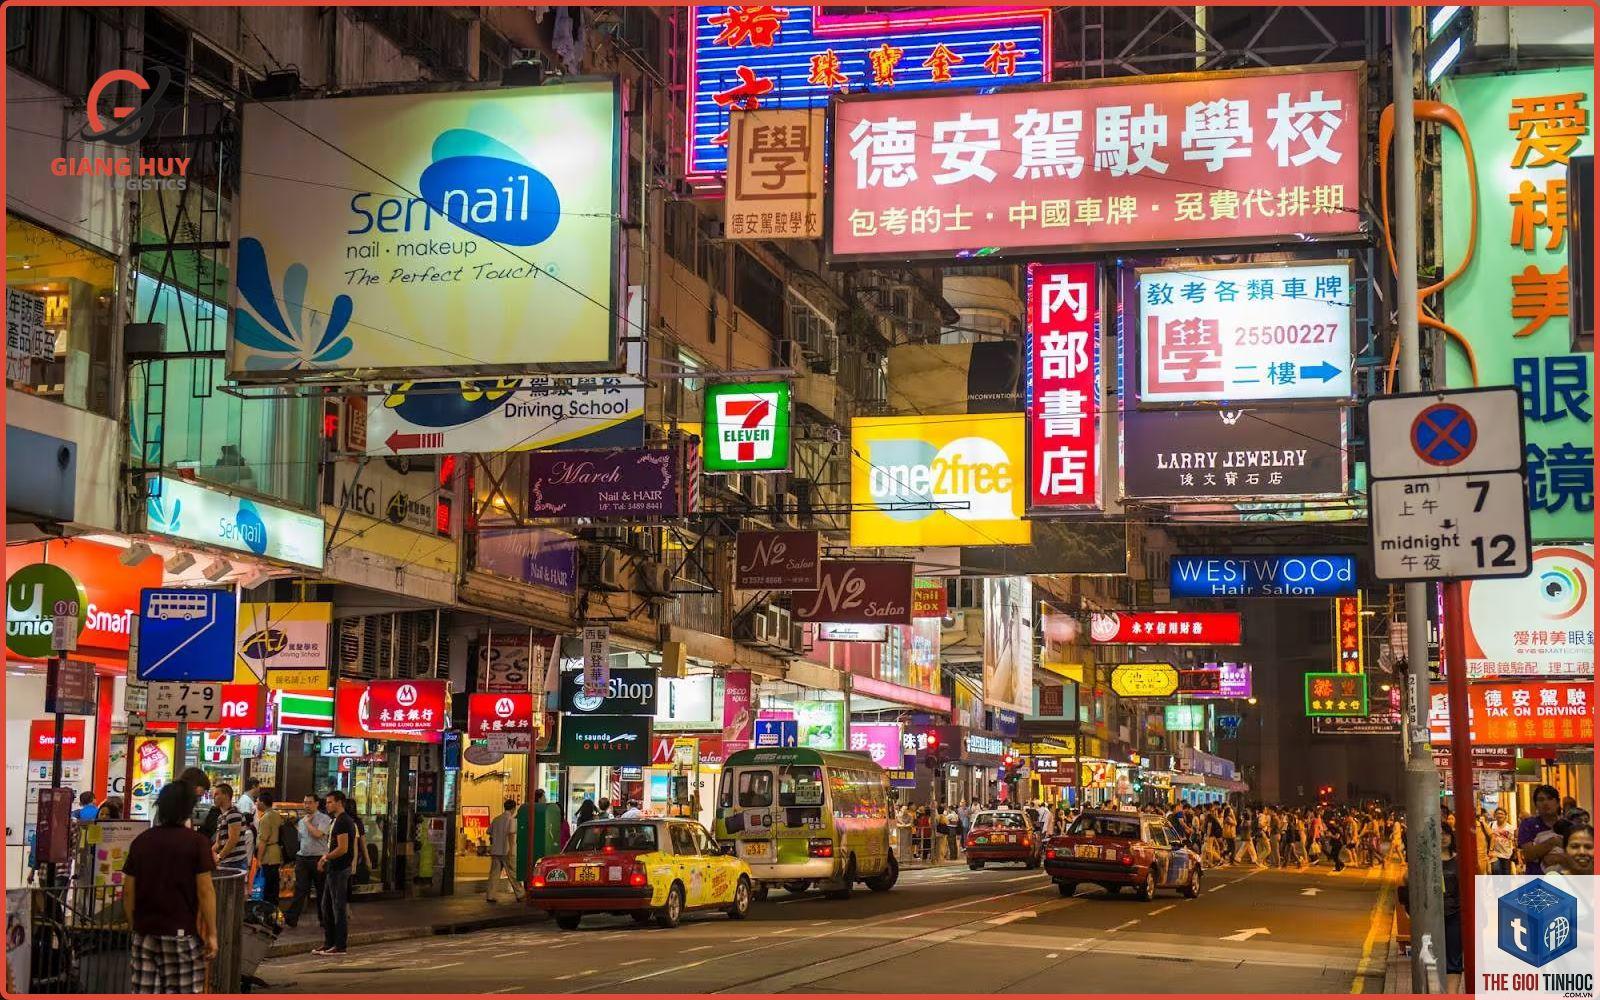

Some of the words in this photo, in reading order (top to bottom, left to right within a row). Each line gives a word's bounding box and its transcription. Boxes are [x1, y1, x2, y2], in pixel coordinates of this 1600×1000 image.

[808, 41, 1024, 88] 珠寶金行
[849, 90, 1344, 190] 德安駕駛學校
[348, 192, 430, 235] Sen
[443, 175, 529, 224] nail
[732, 211, 817, 236] 德安駕駛學校
[346, 242, 380, 259] nail
[396, 240, 478, 257] makeup
[345, 268, 380, 286] The
[388, 265, 464, 284] Perfect
[473, 262, 540, 281] Touch
[1234, 323, 1339, 347] 25500227
[1232, 361, 1297, 385] 二樓
[504, 402, 563, 419] Driving
[569, 399, 629, 415] School
[1157, 452, 1217, 469] LARRY
[1223, 450, 1308, 468] JEWELRY
[548, 461, 623, 485] March
[868, 454, 1013, 498] one2free
[598, 492, 619, 501] Nail
[622, 491, 631, 501] &
[633, 490, 662, 500] HAIR
[1404, 482, 1430, 494] am
[1466, 481, 1490, 512] 7
[1398, 500, 1439, 517] 上午
[741, 535, 786, 572] N2
[1381, 533, 1460, 550] midnight
[1471, 534, 1516, 568] 12
[786, 560, 814, 569] Salon
[1401, 553, 1442, 572] 午夜
[798, 567, 866, 616] N2
[914, 591, 938, 600] Nail
[1212, 584, 1254, 595] Hair
[1262, 583, 1315, 595] Salon
[864, 602, 905, 617] Salon
[914, 601, 939, 611] Box
[1548, 661, 1594, 674] 理工視
[606, 678, 653, 705] Shop
[1485, 689, 1586, 706] 德安駕駛
[379, 709, 434, 721] 永隆銀行
[1486, 708, 1508, 717] TAK
[1514, 708, 1531, 716] ON
[1537, 706, 1586, 716] DRIVING
[39, 735, 77, 744] Smaone
[585, 733, 611, 741] saunda
